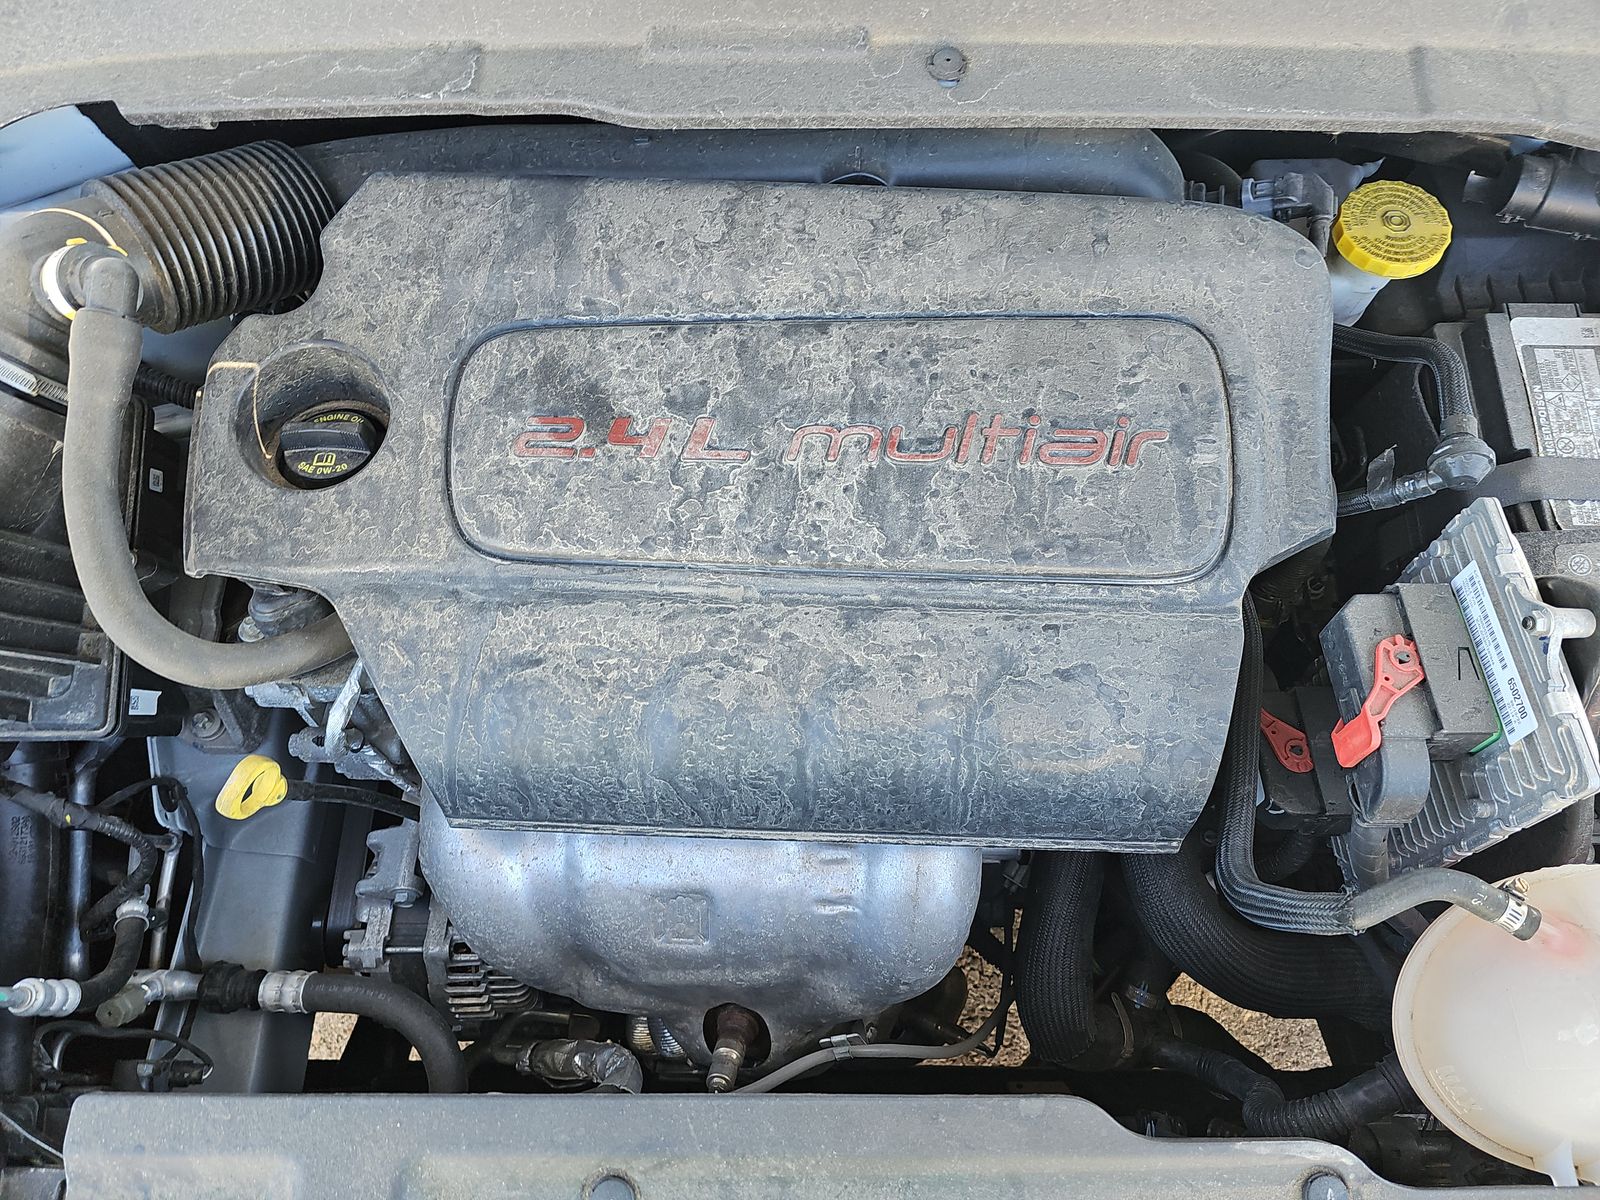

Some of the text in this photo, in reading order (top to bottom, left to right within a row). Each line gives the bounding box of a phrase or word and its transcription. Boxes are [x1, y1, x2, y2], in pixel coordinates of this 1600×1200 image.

[313, 413, 350, 423] ENGINE
[786, 411, 1169, 467] multiair
[297, 461, 348, 475] SAE 0W-20
[1506, 677, 1529, 721] 6502700
